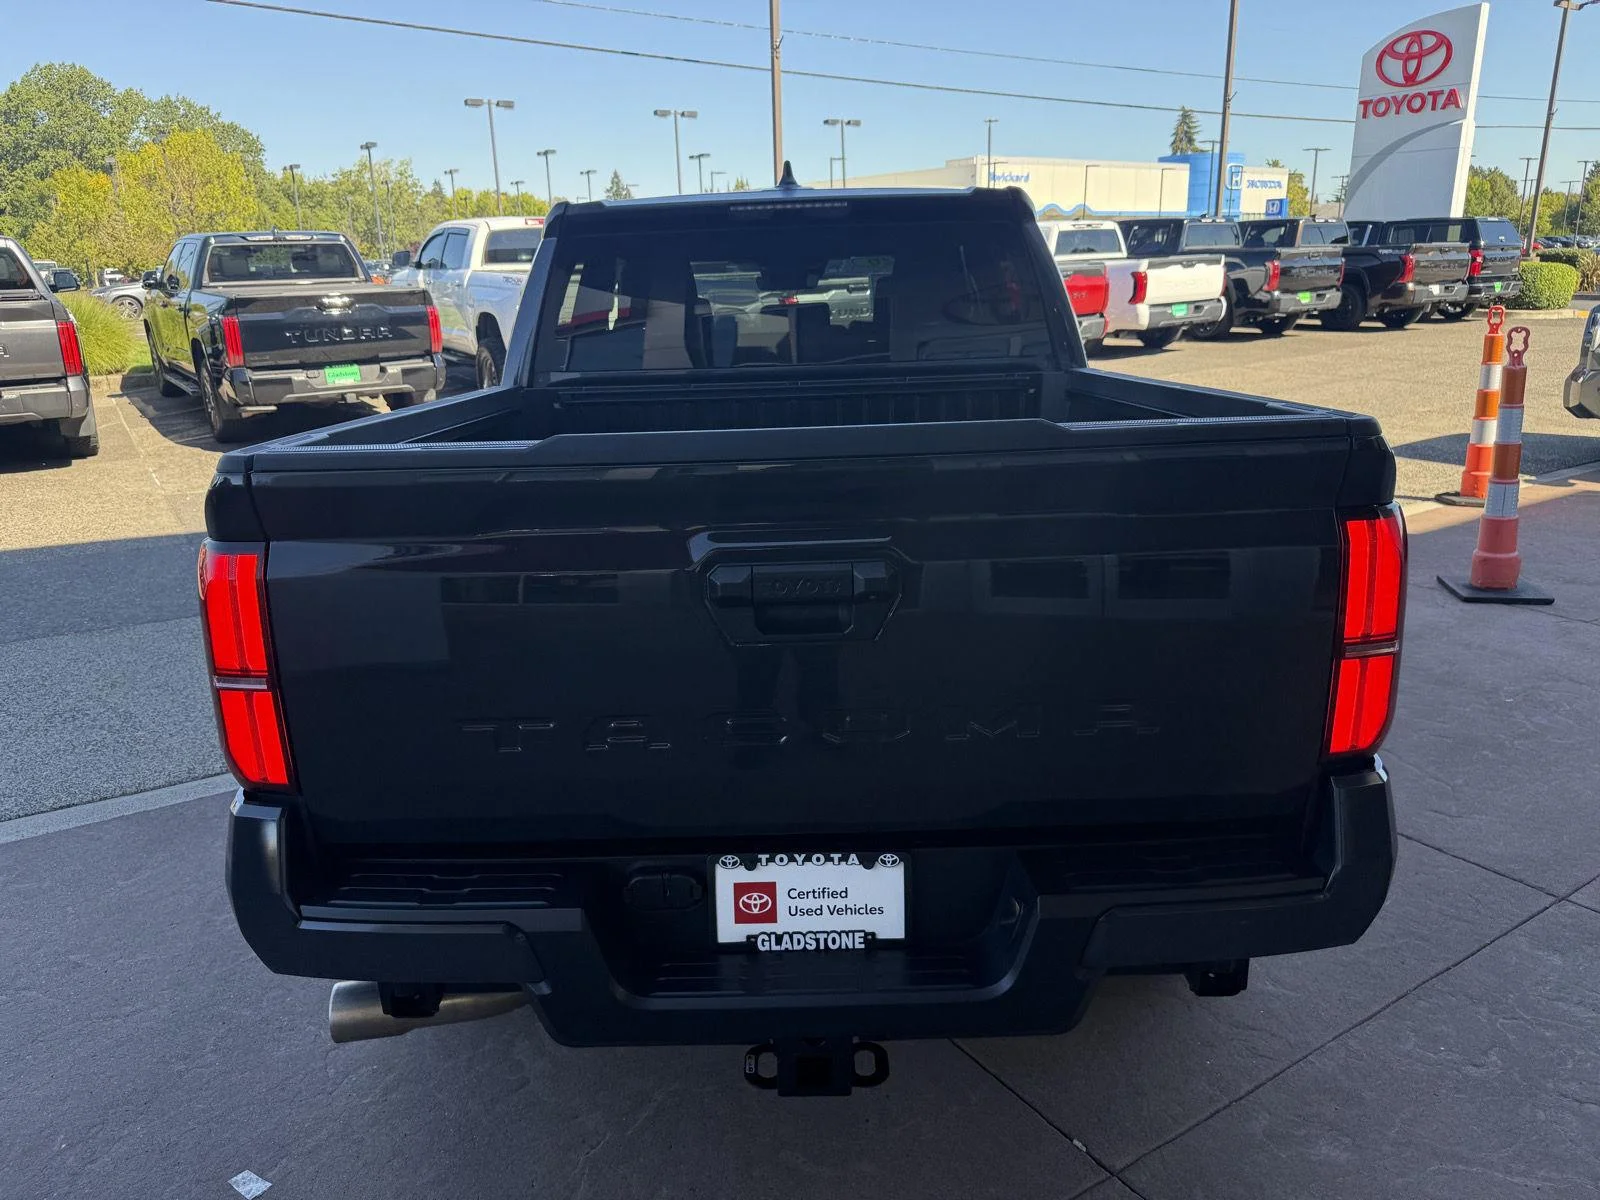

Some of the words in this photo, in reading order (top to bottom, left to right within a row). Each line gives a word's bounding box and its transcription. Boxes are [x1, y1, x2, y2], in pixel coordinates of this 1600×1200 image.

[1359, 88, 1462, 119] TOYOTA
[285, 326, 392, 344] TUNDRA
[460, 703, 1161, 753] TACOMA
[758, 853, 860, 866] TOYOTA
[787, 887, 849, 900] Certified
[788, 905, 823, 917] Used
[827, 904, 884, 917] Vehicles
[756, 932, 865, 951] GLADSTONE
